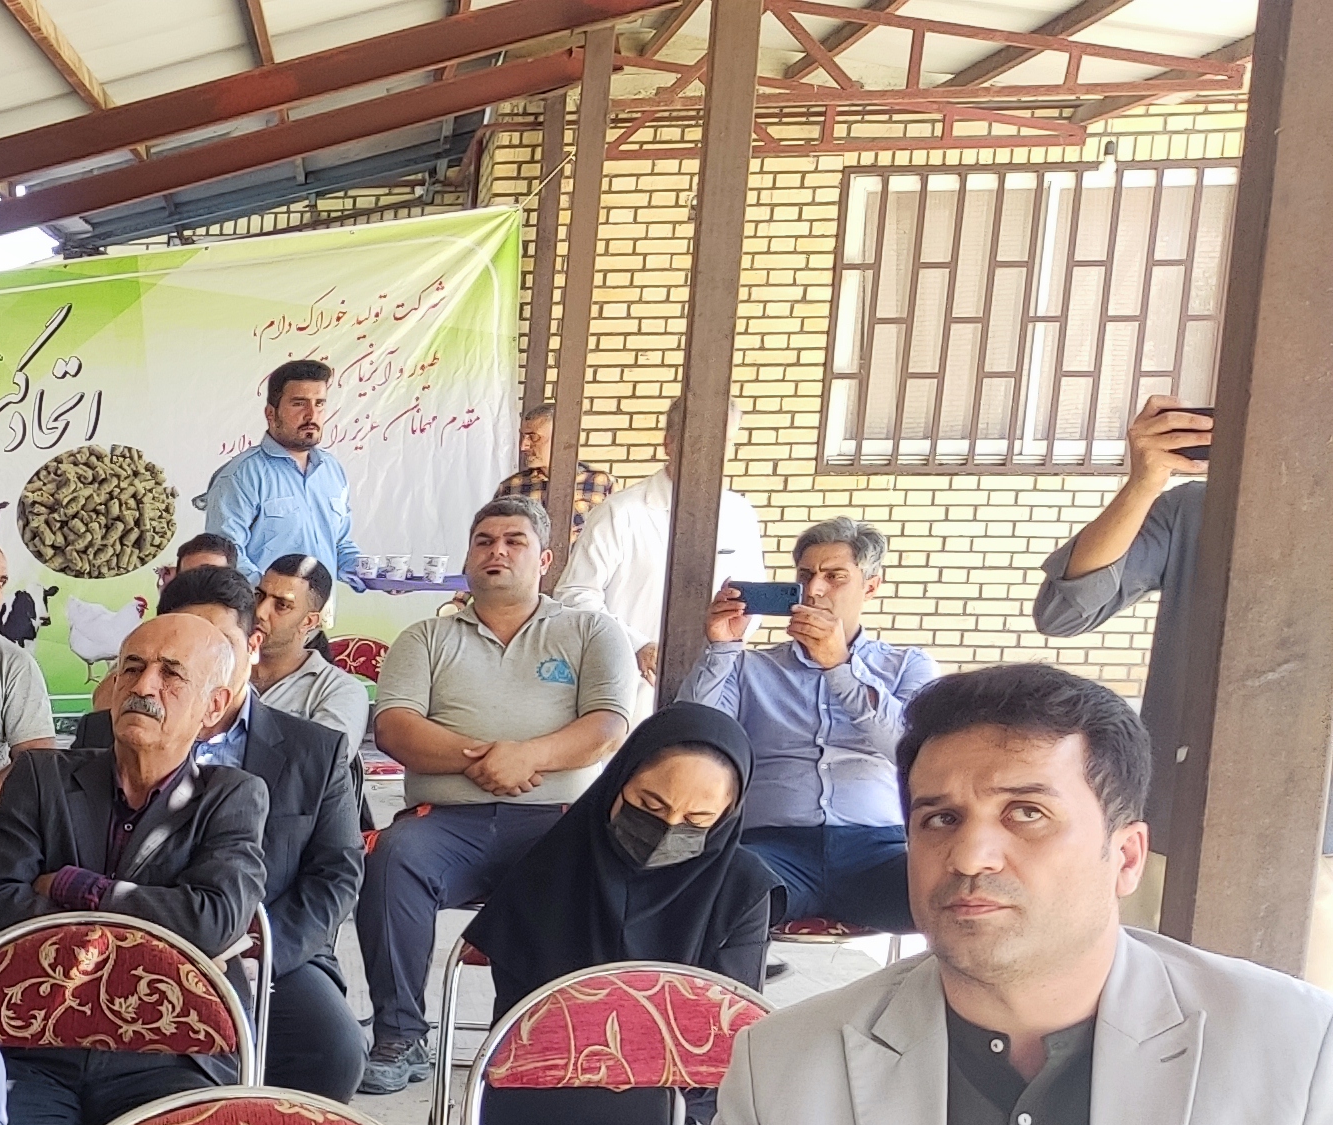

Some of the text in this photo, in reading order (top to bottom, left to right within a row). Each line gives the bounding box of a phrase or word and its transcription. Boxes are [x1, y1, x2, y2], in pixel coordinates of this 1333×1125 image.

[295, 285, 348, 336] خوراک
[351, 292, 388, 341] تولید
[392, 272, 448, 323] شرکت
[337, 342, 400, 398] آبزیان
[396, 365, 404, 380] و
[407, 350, 440, 391] طیور
[3, 355, 103, 453] اتحاد
[383, 396, 437, 441] مهمانان
[322, 424, 347, 449] را
[349, 414, 380, 450] عزیز
[440, 408, 481, 450] مقدم
